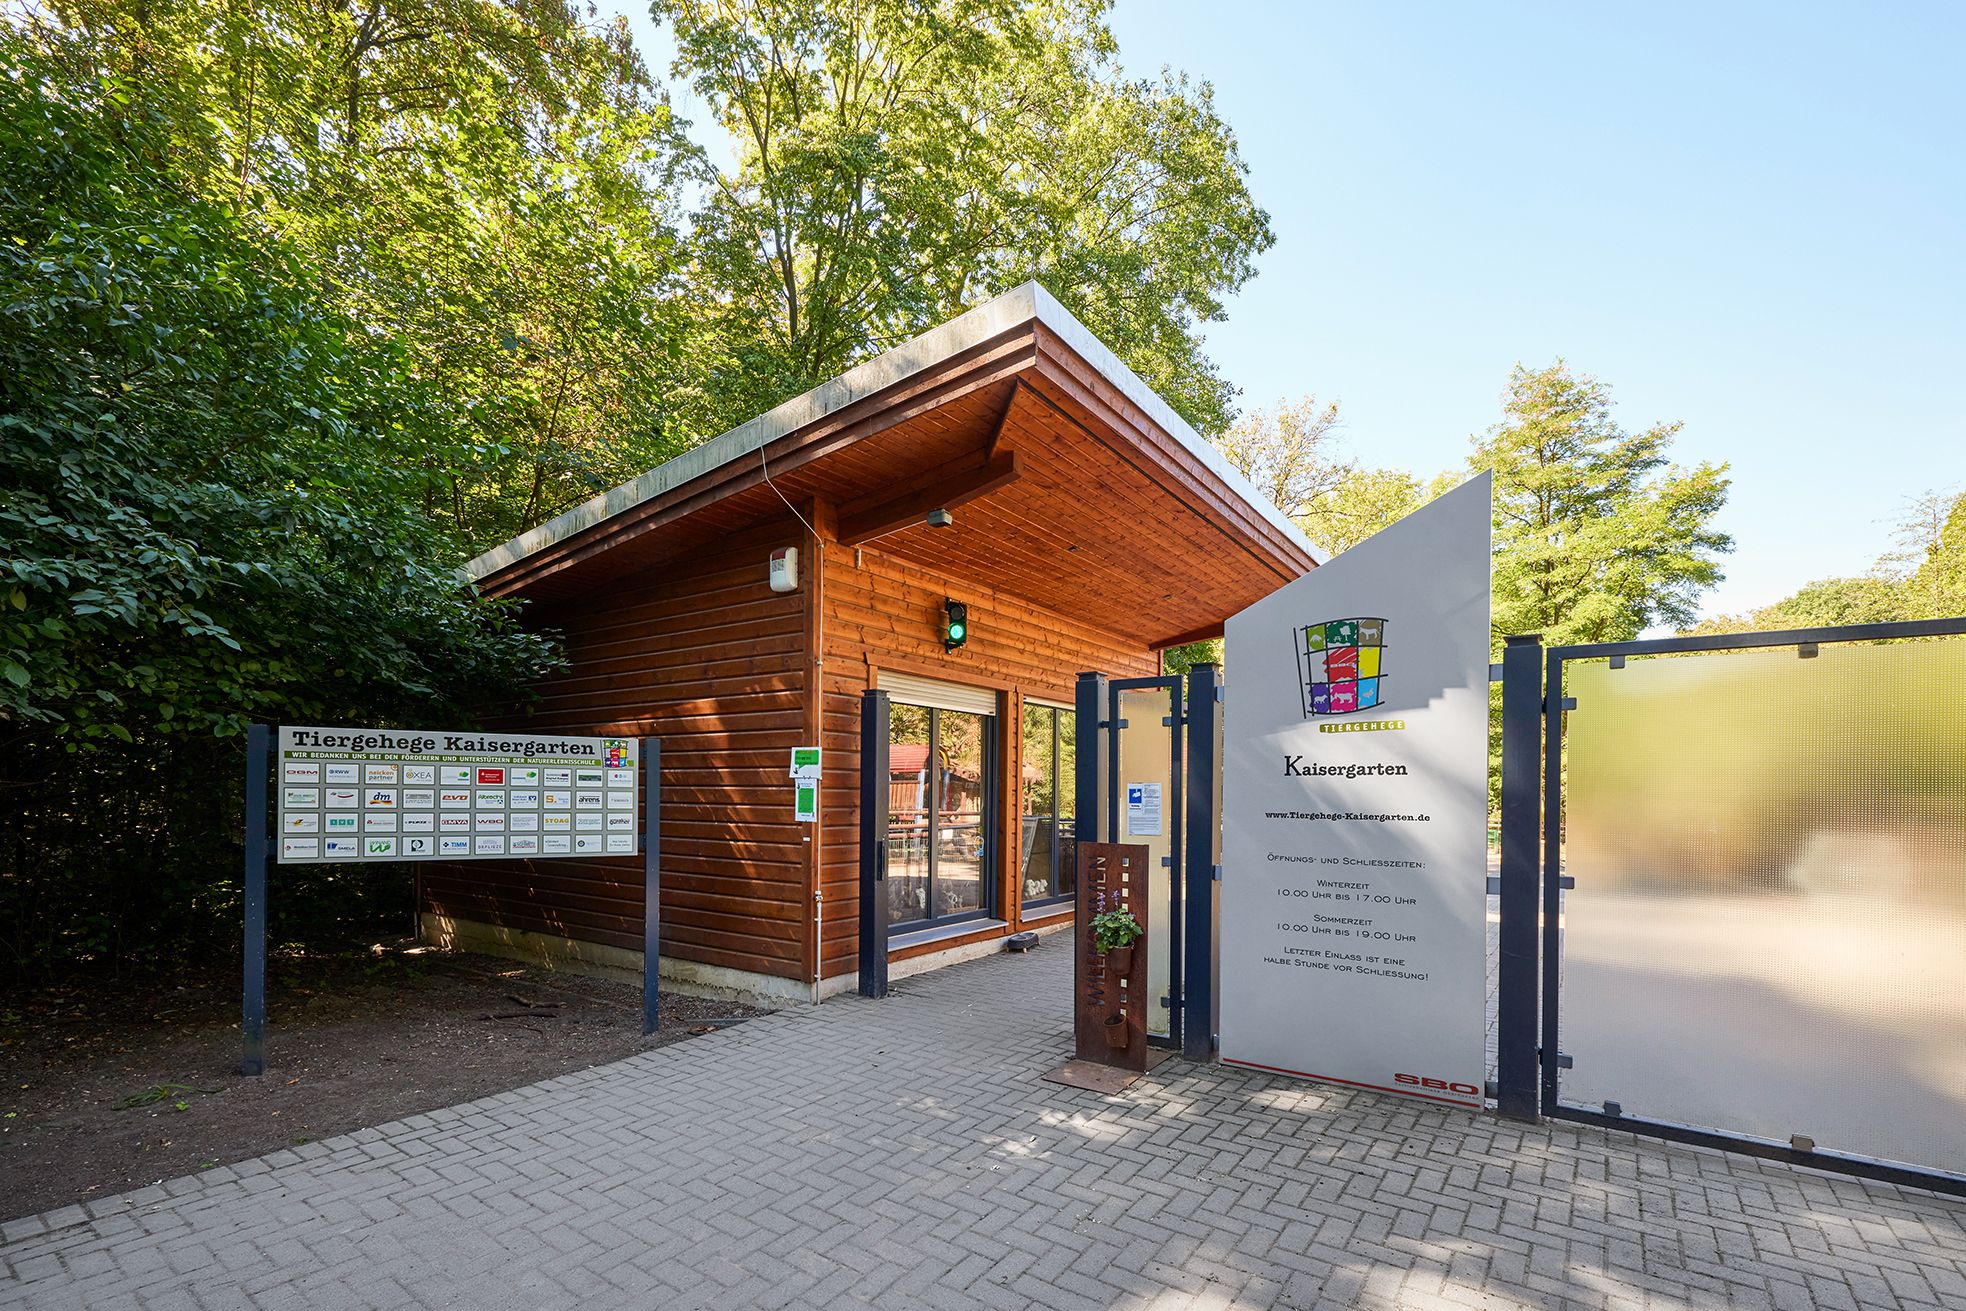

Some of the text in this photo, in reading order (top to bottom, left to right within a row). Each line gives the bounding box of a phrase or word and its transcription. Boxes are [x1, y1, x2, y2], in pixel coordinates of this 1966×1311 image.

[1323, 721, 1403, 732] TIERGEHEGE
[292, 731, 595, 757] Tiergehege Kaisergarten
[401, 753, 440, 761] FÖRDERERN
[459, 755, 510, 763] UNTERSTÜTZERN
[527, 757, 595, 765] NATURERLEBNISSCHULE
[1284, 755, 1408, 779] Kaisergarten
[373, 792, 390, 801] dm
[1265, 812, 1431, 822] www.Tiergehege-Kaisergarten.de
[1316, 880, 1370, 890] WINTERZEIT
[1277, 889, 1309, 898] 10.00
[1312, 891, 1332, 900] UHR
[1356, 894, 1391, 904] 17.00
[1395, 896, 1417, 906] UHR
[1313, 914, 1373, 926] SOMMERZEIT
[1277, 923, 1417, 943] 10.00 UHR BIS 19.00 UHR
[1284, 946, 1322, 957] LETZTER
[1325, 950, 1362, 962] EINLASS
[1383, 957, 1406, 966] EINE
[1263, 957, 1429, 981] HALBE STUNDE VOR SCHLIESSUNG!
[1394, 1073, 1479, 1096] SBO
